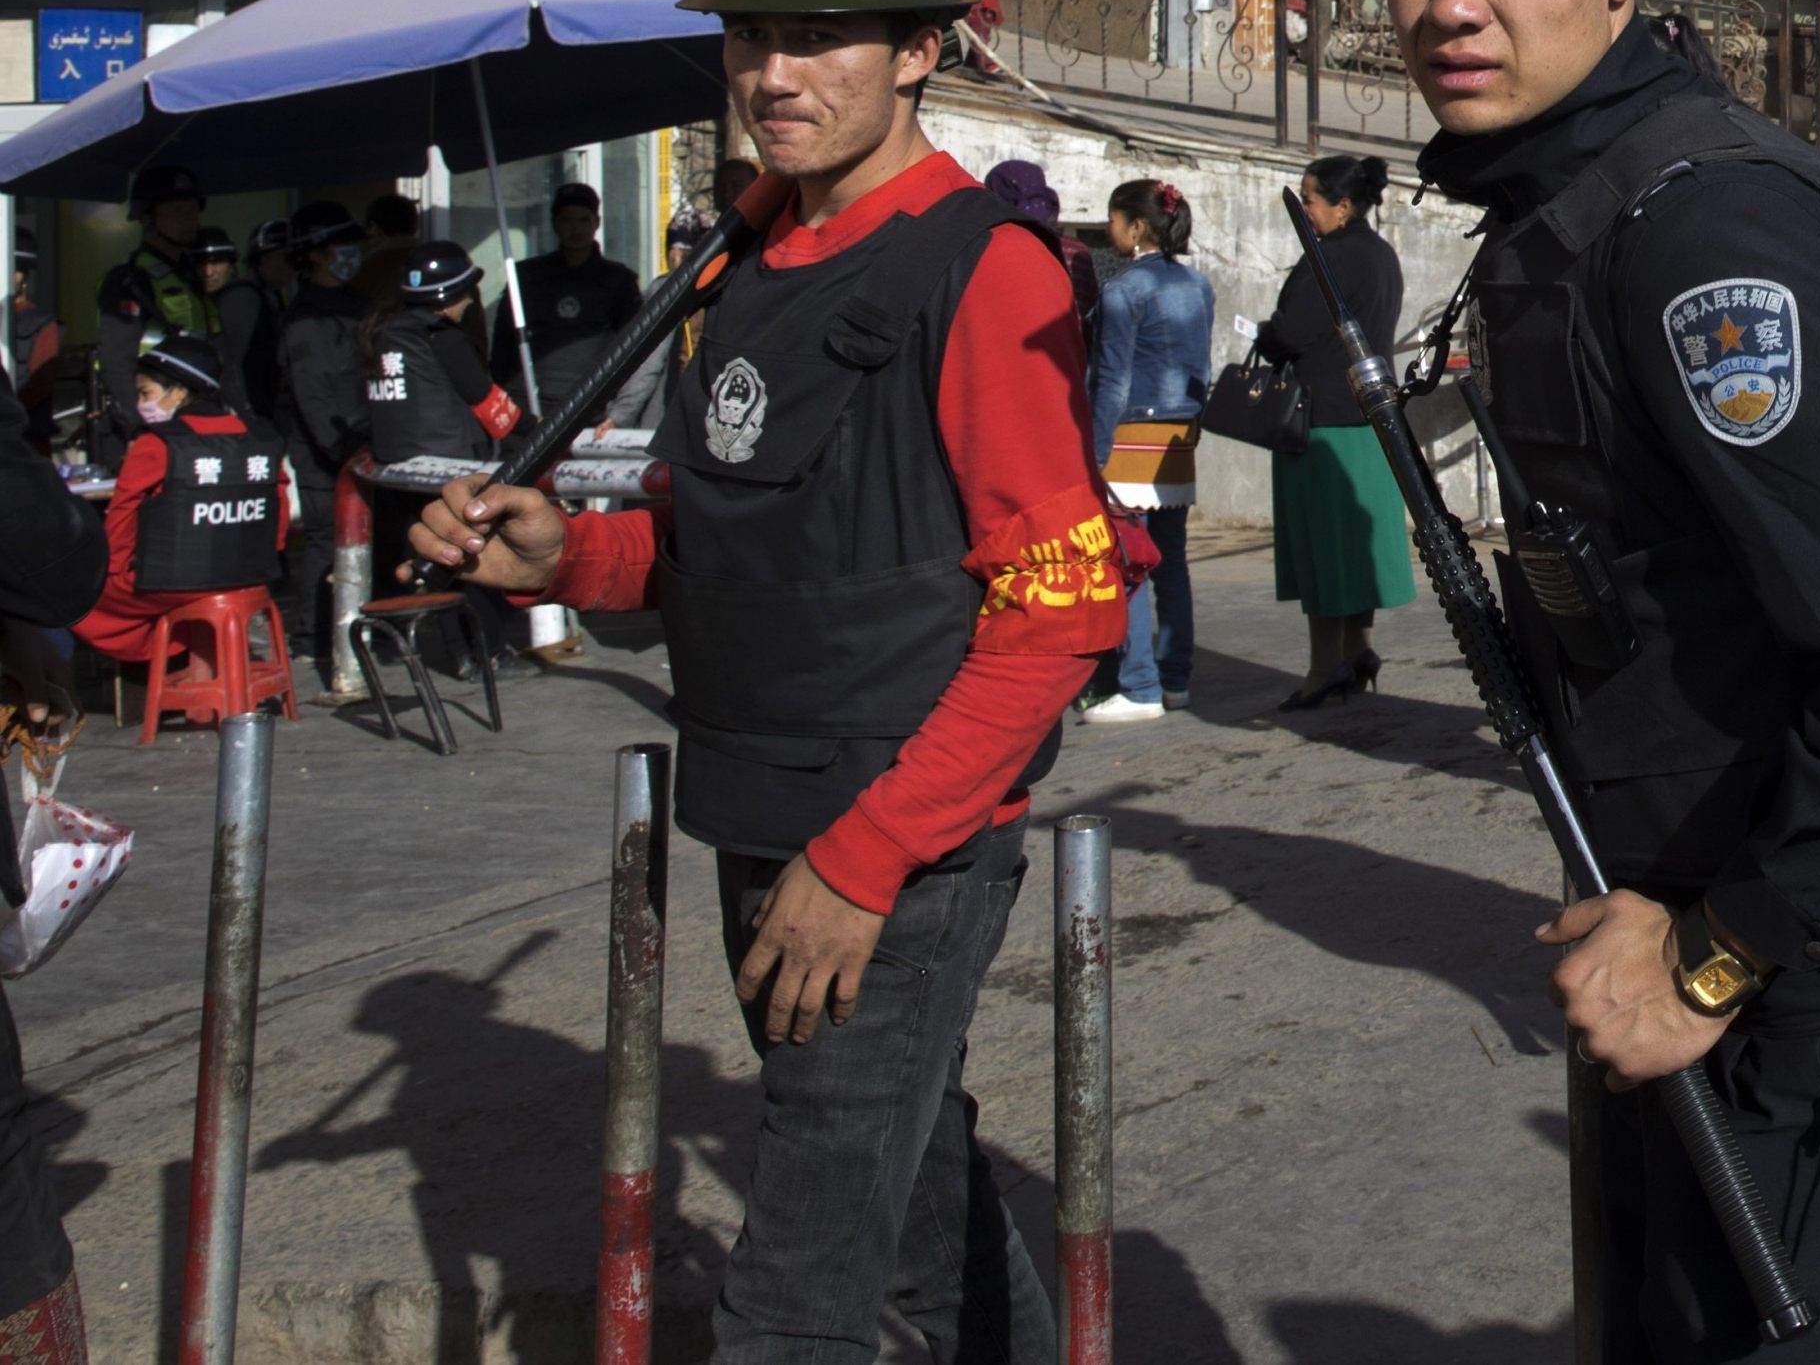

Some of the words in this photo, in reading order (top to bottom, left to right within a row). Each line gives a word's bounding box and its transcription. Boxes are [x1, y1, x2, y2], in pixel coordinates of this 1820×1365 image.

[59, 58, 125, 80] 入口
[1671, 287, 1785, 334] 中华人民共和国
[1682, 318, 1784, 367] 警察
[379, 351, 405, 378] 察
[1712, 358, 1763, 379] POLICE
[1724, 378, 1761, 397] 公安
[193, 454, 270, 486] 警察
[193, 497, 267, 526] POLICE
